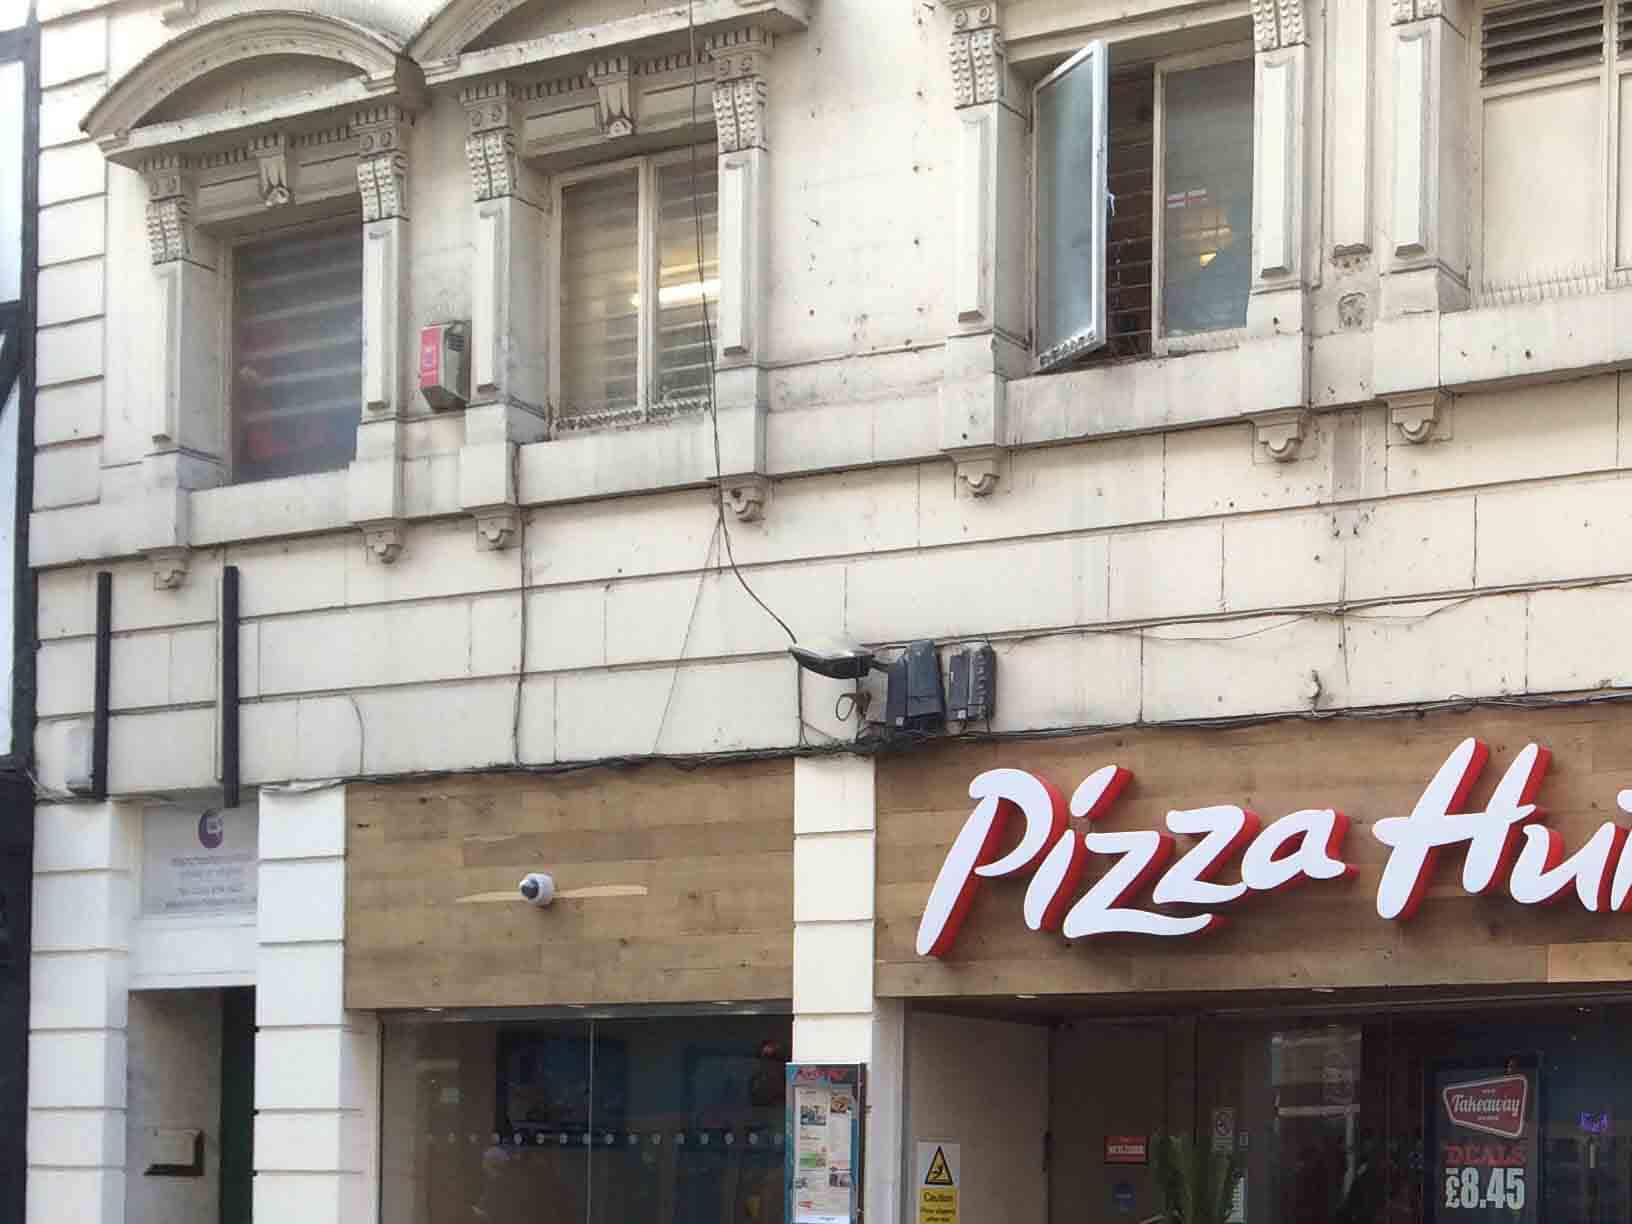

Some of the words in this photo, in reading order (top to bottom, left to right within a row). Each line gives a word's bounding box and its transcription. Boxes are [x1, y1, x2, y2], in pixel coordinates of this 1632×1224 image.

[916, 763, 1360, 957] Pizza
[1452, 1093, 1520, 1117] Takeaway
[1445, 1167, 1525, 1210] £8.45
